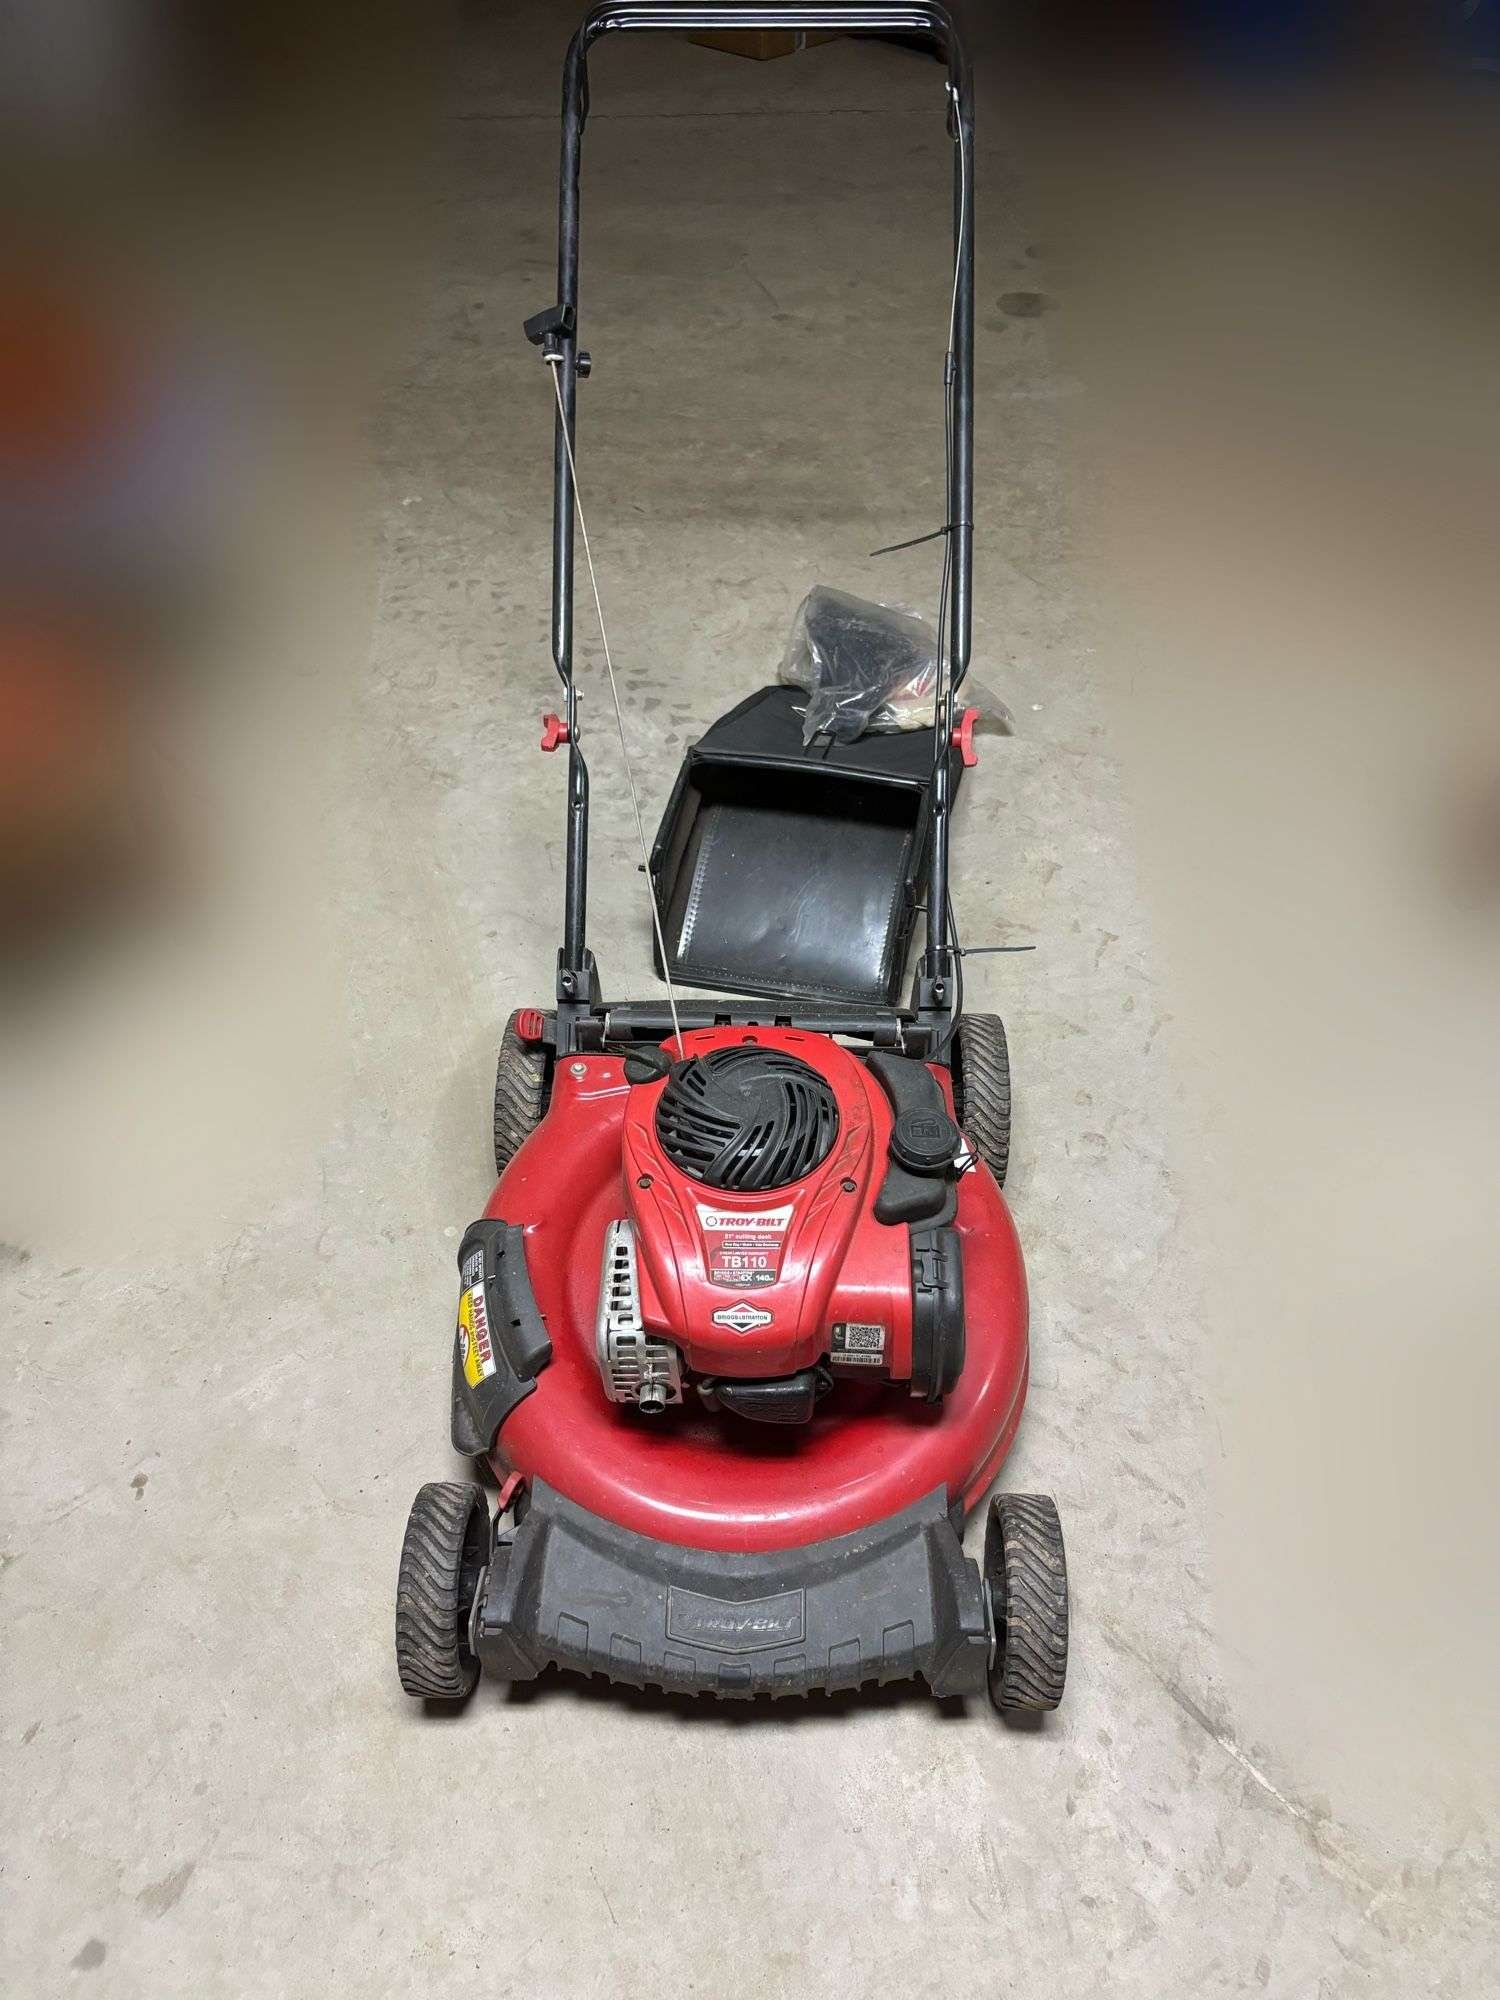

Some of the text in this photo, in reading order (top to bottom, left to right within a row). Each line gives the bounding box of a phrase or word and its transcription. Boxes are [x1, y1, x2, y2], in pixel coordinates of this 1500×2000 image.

[719, 1217, 785, 1227] TROY-BILT
[721, 1255, 768, 1268] TB110
[473, 1295, 492, 1363] DANGER
